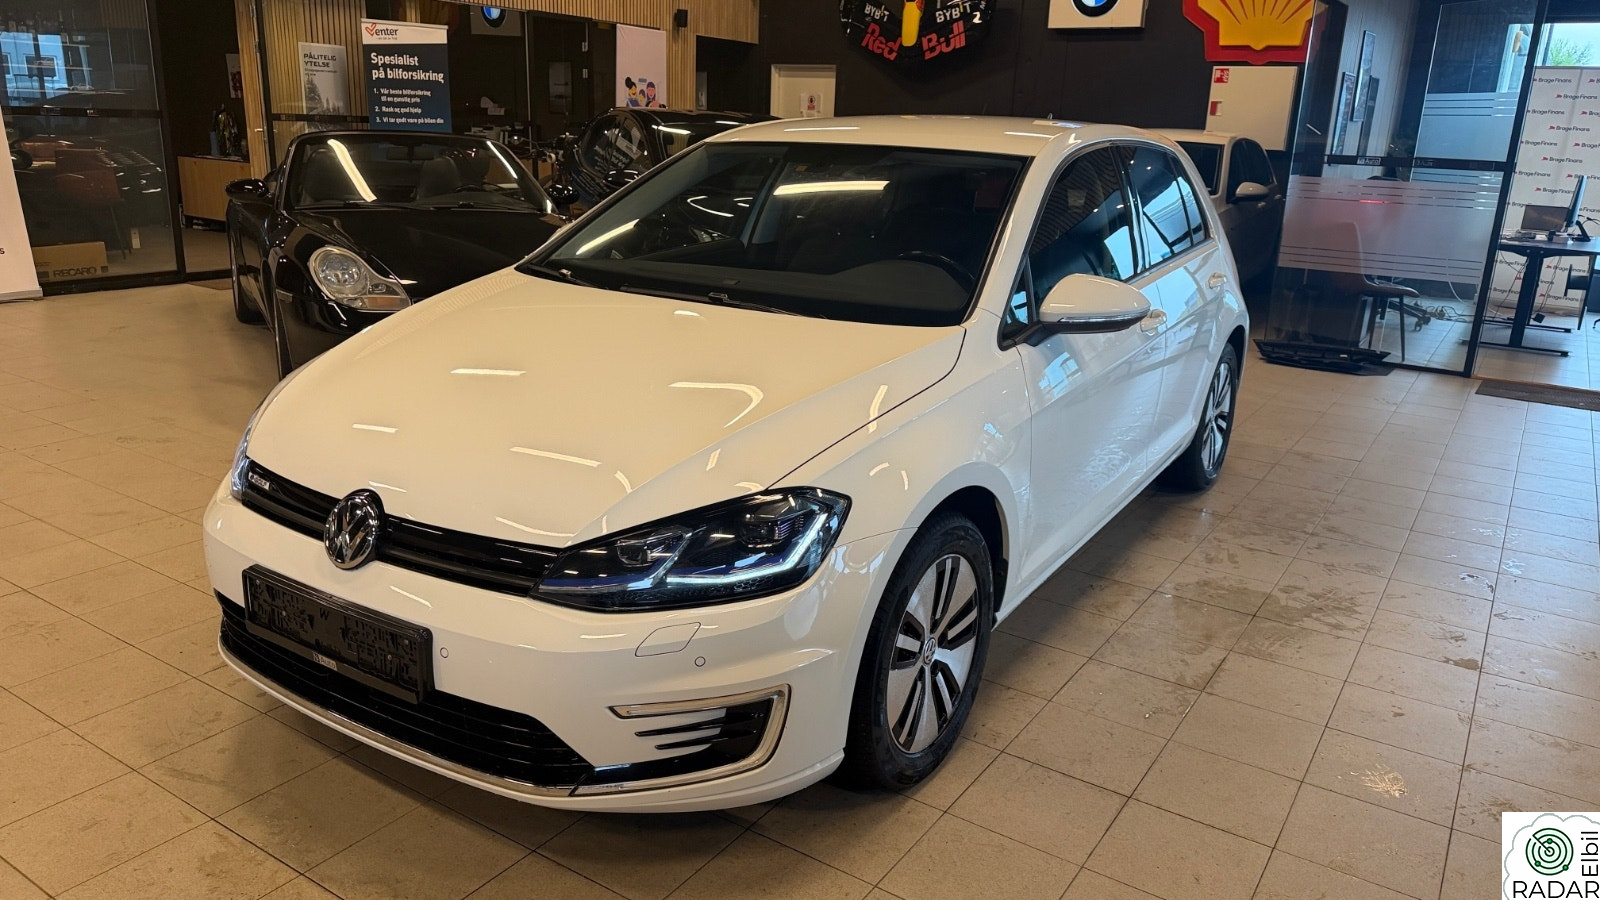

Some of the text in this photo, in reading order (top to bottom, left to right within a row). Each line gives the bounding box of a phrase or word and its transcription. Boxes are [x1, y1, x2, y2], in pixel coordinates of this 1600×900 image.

[972, 11, 982, 23] 2
[861, 20, 966, 61] Red Bull
[303, 52, 337, 61] PÅLITELIG
[370, 52, 419, 66] Spesialist
[303, 60, 330, 68] YTELSE
[372, 67, 445, 84] på bilforsikring
[53, 266, 97, 278] RECARO
